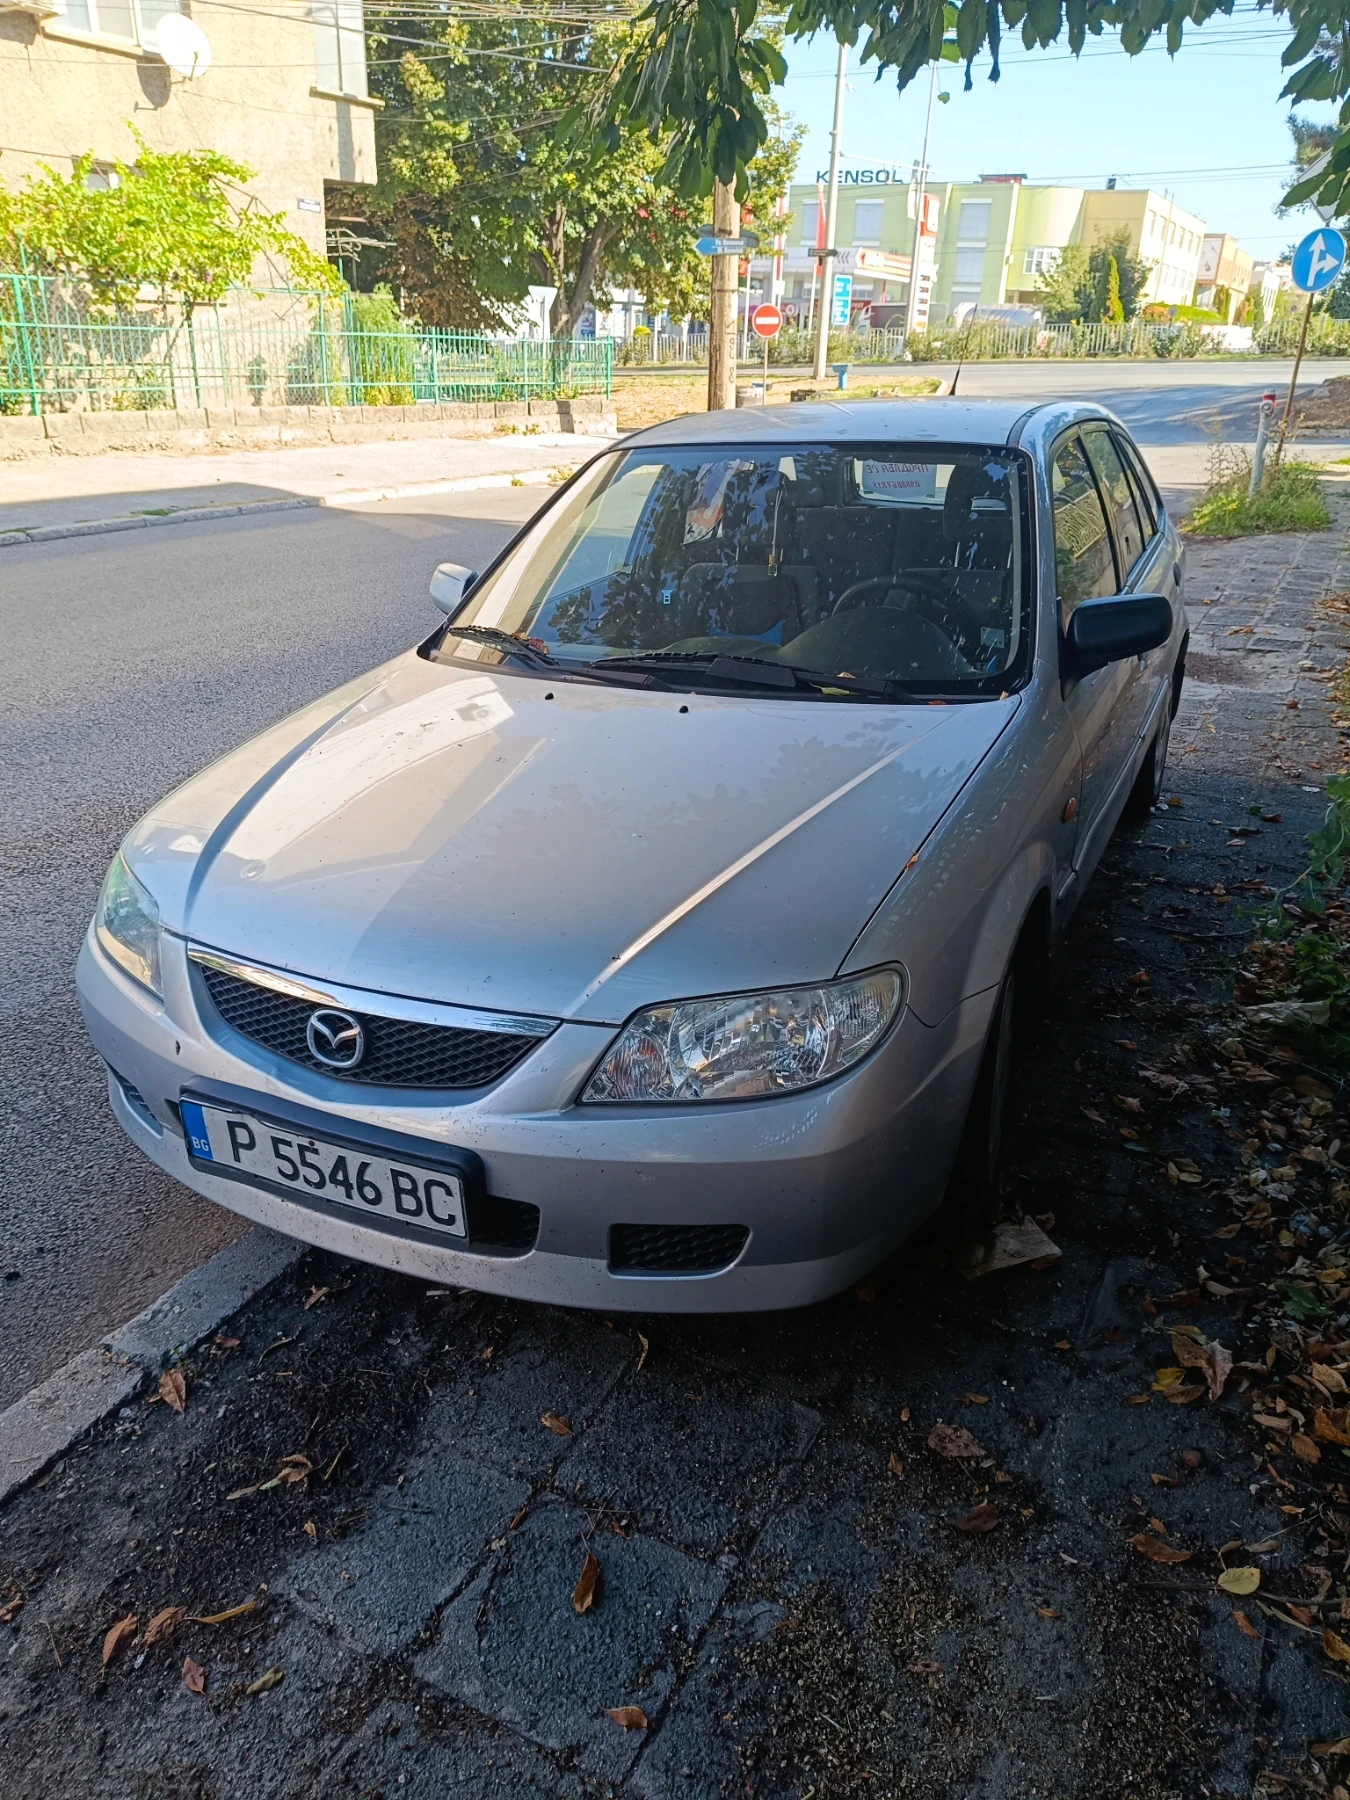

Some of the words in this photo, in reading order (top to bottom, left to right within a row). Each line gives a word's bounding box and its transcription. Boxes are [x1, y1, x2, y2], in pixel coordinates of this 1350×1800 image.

[191, 1135, 210, 1152] BG
[226, 1119, 257, 1164] P
[270, 1135, 383, 1206] 5546
[389, 1167, 456, 1227] BC
